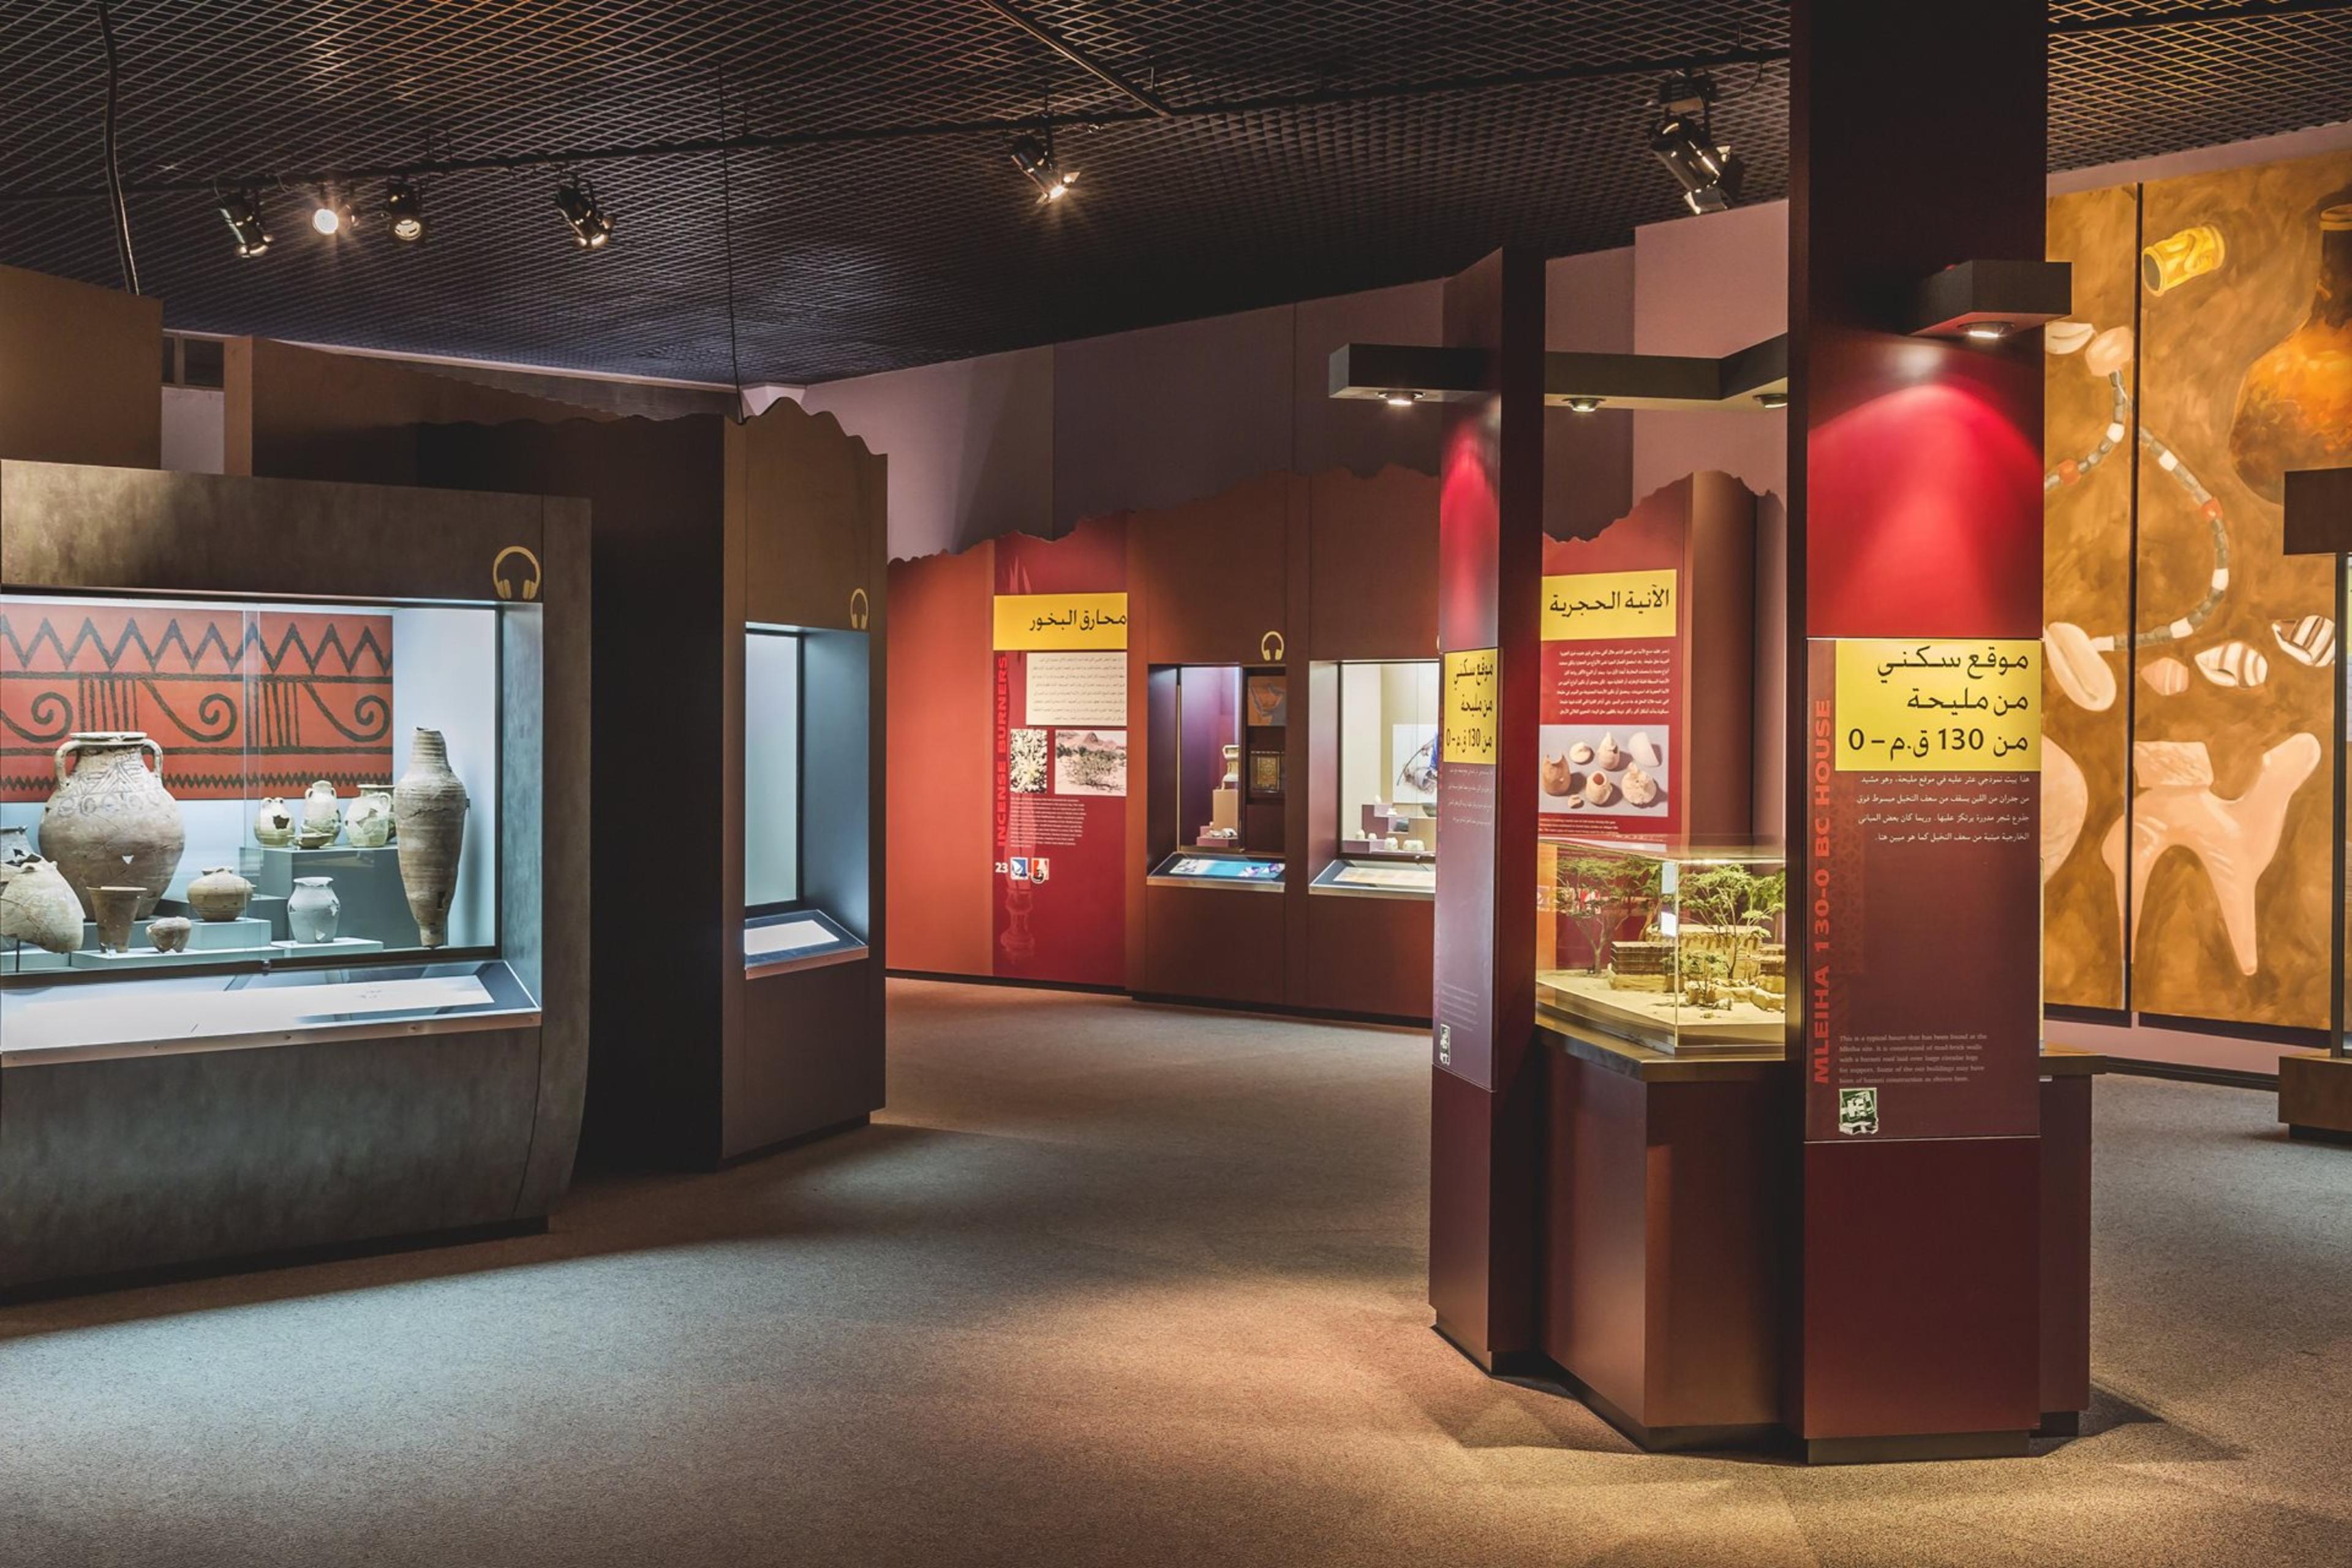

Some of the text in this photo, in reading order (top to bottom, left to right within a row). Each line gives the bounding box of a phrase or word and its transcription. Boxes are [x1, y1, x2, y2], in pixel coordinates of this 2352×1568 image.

[1550, 584, 1669, 617] الآنية الحجرية
[1029, 609, 1127, 631] محارق البخور
[1454, 657, 1493, 691] موقع سكني
[1877, 645, 2029, 684] موقع سكني
[1461, 693, 1493, 717] من مليحة
[1907, 687, 2029, 716] من مليحة
[1468, 728, 1481, 747] 130
[1482, 736, 1492, 753] من
[1938, 728, 1985, 750] 130
[1993, 736, 2029, 757] من
[998, 656, 1008, 846] INCENSE BURNERS
[1919, 775, 1935, 786] موقع
[1936, 775, 1947, 786] في
[1948, 774, 1962, 785] عليه
[1856, 794, 1870, 804] فوق
[1896, 794, 1919, 804] النخيل
[1901, 813, 1913, 823] كان
[995, 862, 1009, 873] 23
[1814, 699, 1830, 1084] MLEIHA 130-0 BC HOUSE
[1866, 1034, 1887, 1043] typical
